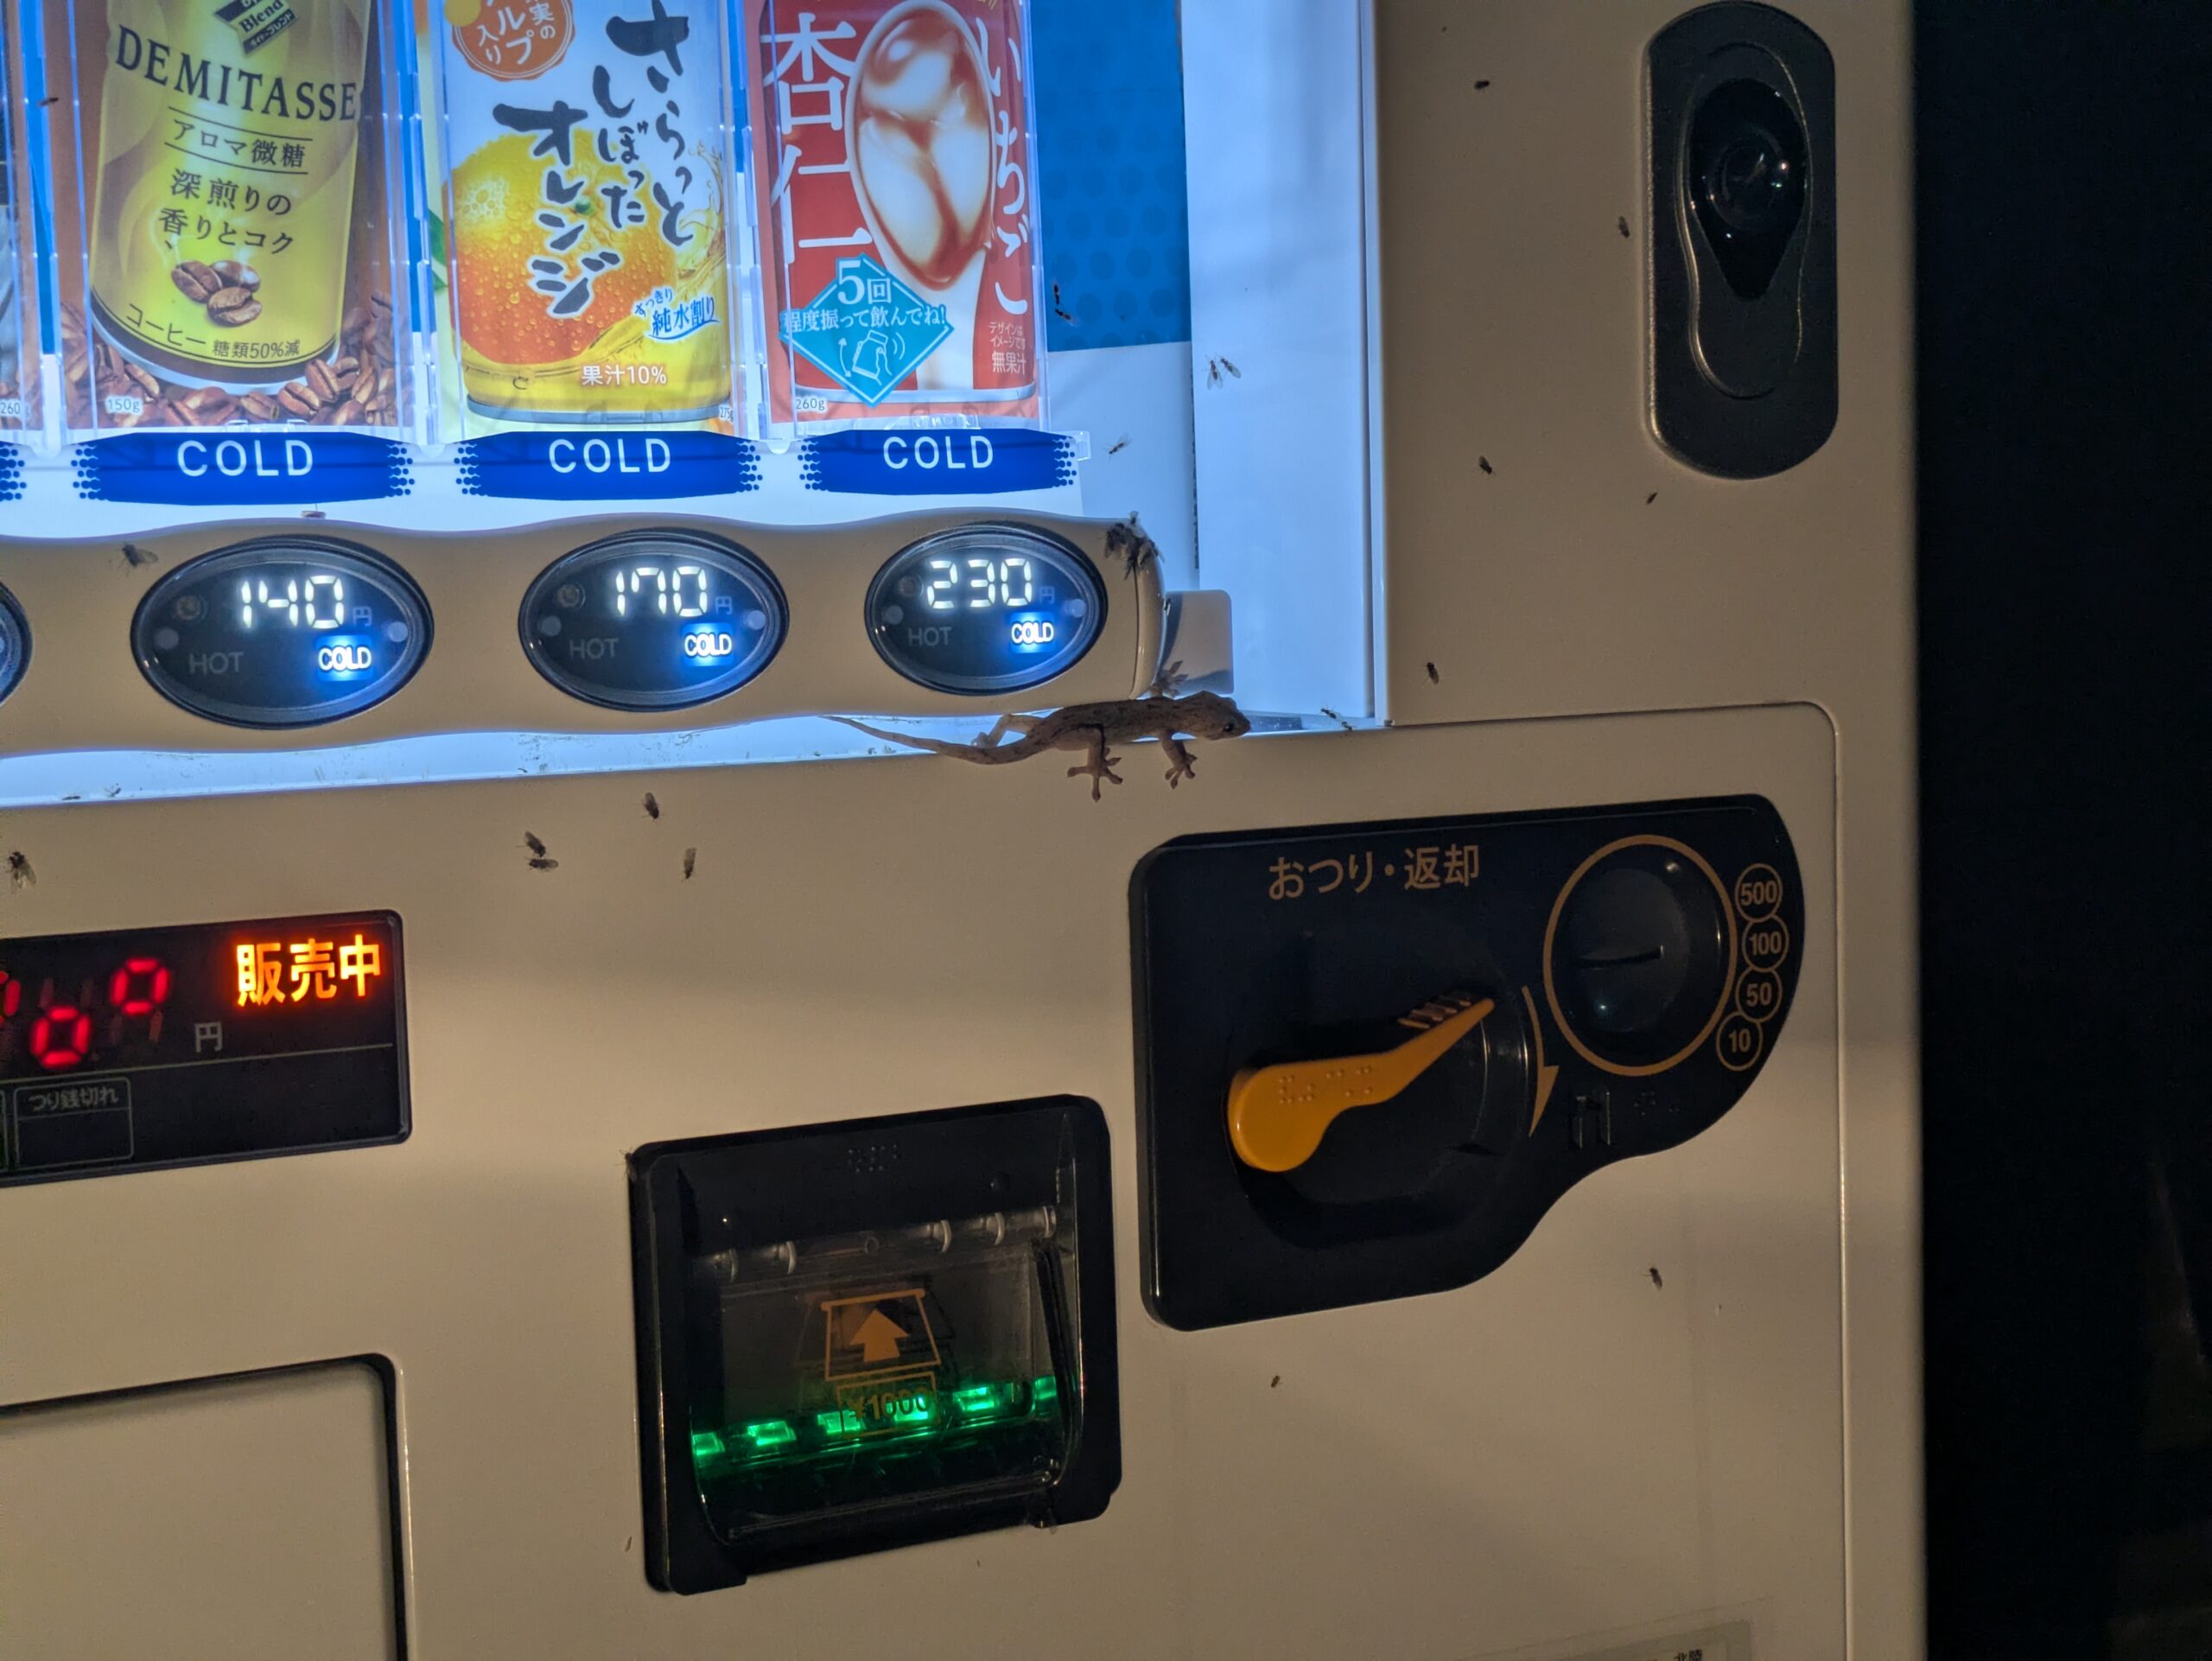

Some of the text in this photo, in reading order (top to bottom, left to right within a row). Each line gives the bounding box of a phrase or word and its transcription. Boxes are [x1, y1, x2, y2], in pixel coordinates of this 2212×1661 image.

[486, 0, 535, 65] ルプ
[115, 23, 358, 122] DEMITASSE
[172, 118, 306, 169] アロマ微糖
[170, 168, 292, 216] 深煎りの
[837, 259, 893, 305] 5回
[126, 302, 207, 347] コーヒー
[652, 296, 715, 336] 純水割り
[213, 339, 302, 360] 糖類50%減
[991, 350, 1027, 376] 無果汁
[581, 365, 667, 386] 果汁10%
[106, 397, 141, 414] 150g
[795, 397, 826, 410] 260g
[177, 439, 314, 477] COLD
[548, 437, 671, 474] COLD
[883, 435, 994, 469] COLD
[615, 566, 709, 617] 170
[926, 557, 1033, 609] 230
[240, 575, 345, 629] 140
[683, 633, 733, 657] COLD
[908, 627, 952, 648] HOT
[1011, 621, 1055, 644] COLD
[317, 646, 372, 671] COLD
[569, 638, 619, 660] HOT
[188, 652, 244, 676] HOT
[1268, 843, 1480, 901] おつり・返却
[1740, 880, 1778, 906] 500
[1749, 931, 1783, 956] 100
[235, 932, 382, 1008] 販売中
[1746, 981, 1772, 1008] 50
[194, 1021, 224, 1053] 円
[1729, 1028, 1751, 1053] 10
[29, 1085, 119, 1111] つり銭切れ
